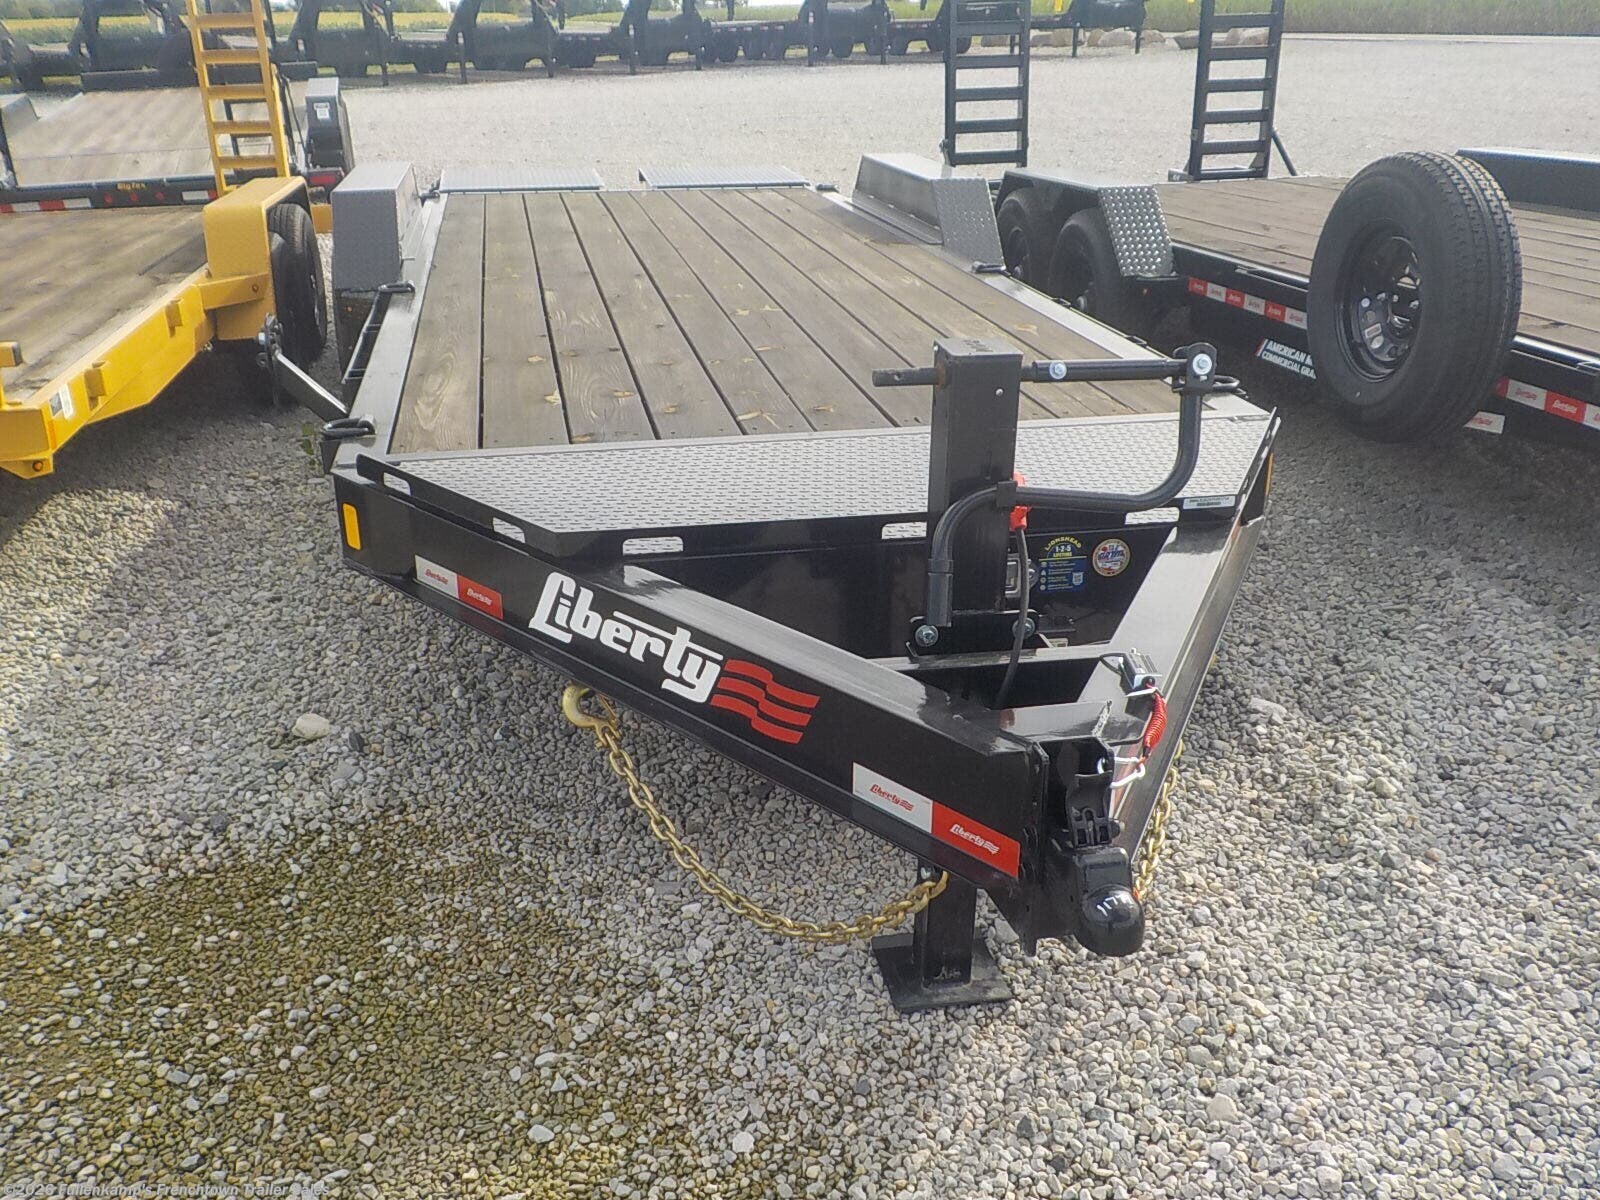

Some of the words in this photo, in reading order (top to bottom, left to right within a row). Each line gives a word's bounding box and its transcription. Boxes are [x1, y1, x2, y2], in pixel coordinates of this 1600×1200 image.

[1266, 340, 1306, 361] AMERICAN
[1261, 351, 1301, 373] COMMERCIAL
[528, 571, 724, 703] Liberty
[869, 783, 901, 805] Liberty
[949, 823, 985, 847] Liberty
